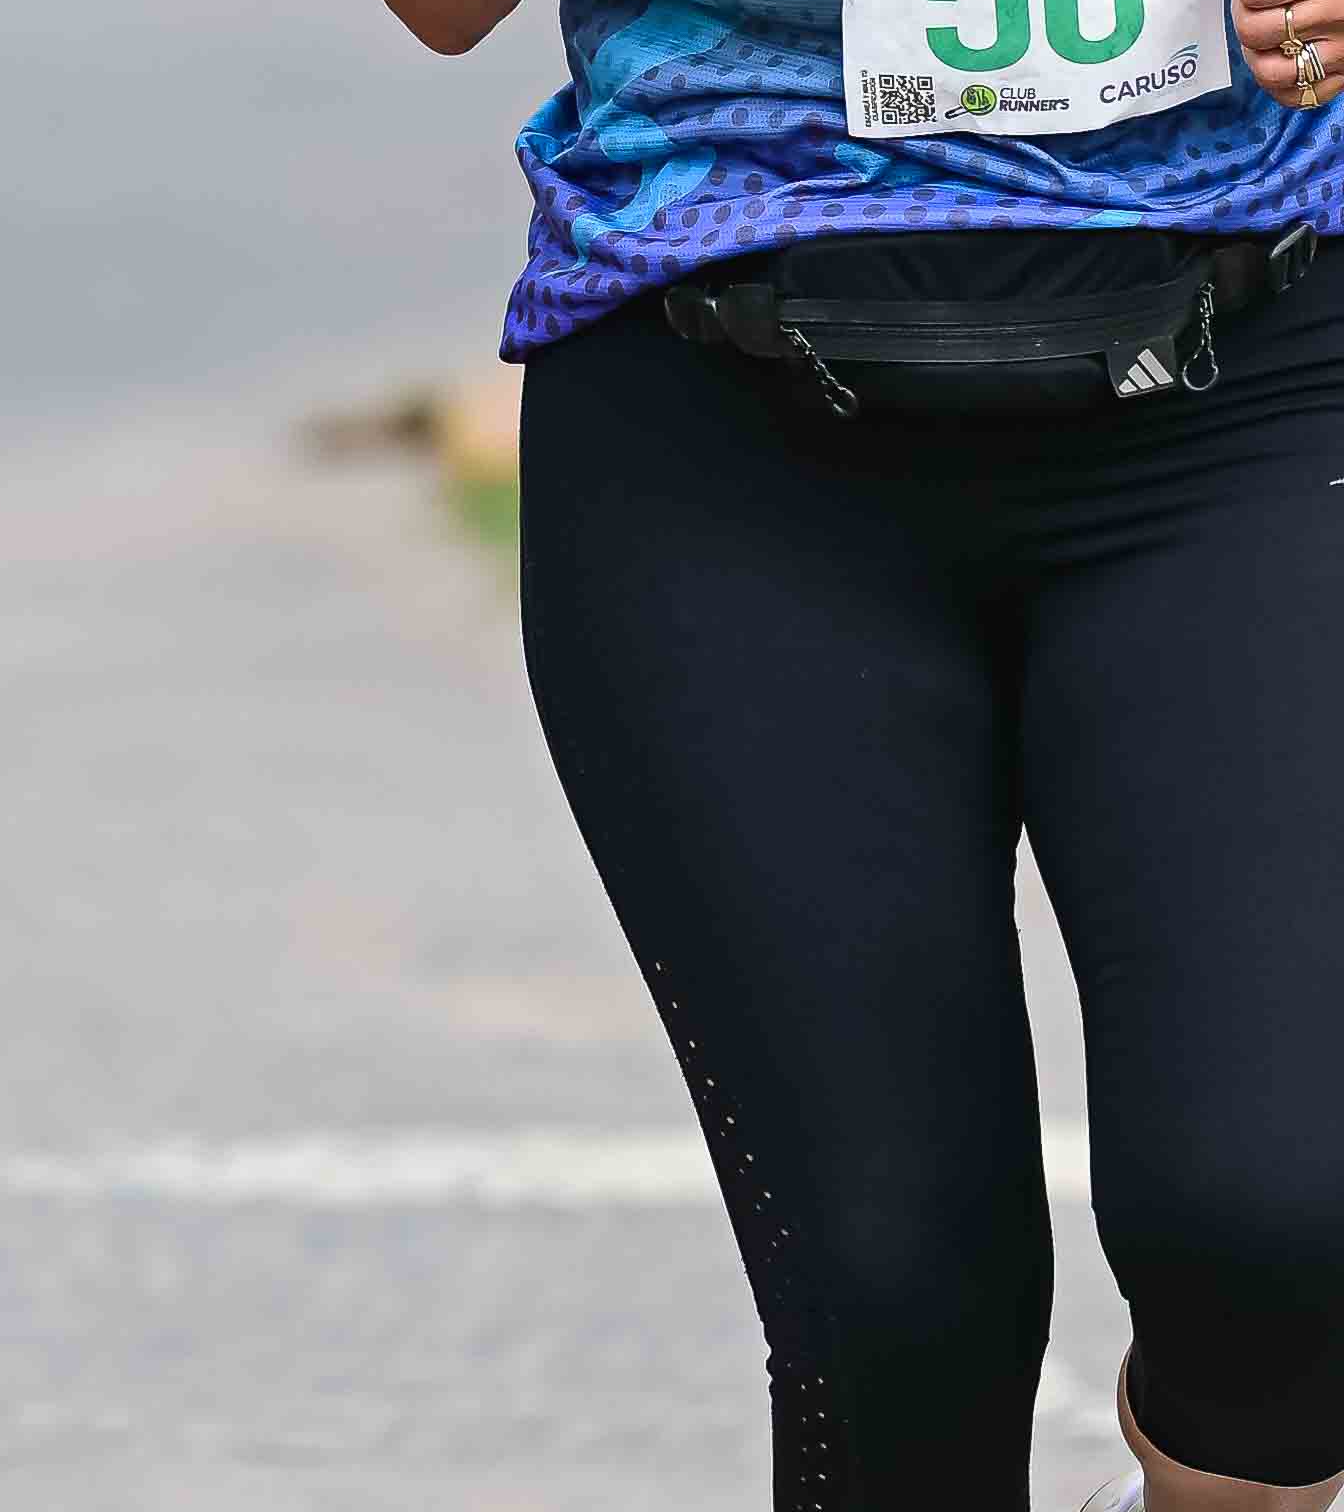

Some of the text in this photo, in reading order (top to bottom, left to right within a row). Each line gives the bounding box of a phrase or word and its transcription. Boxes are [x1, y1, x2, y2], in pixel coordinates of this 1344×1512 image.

[1099, 59, 1197, 104] CARUSO
[999, 87, 1036, 100] CLUB
[998, 98, 1070, 113] RUNNER'S
